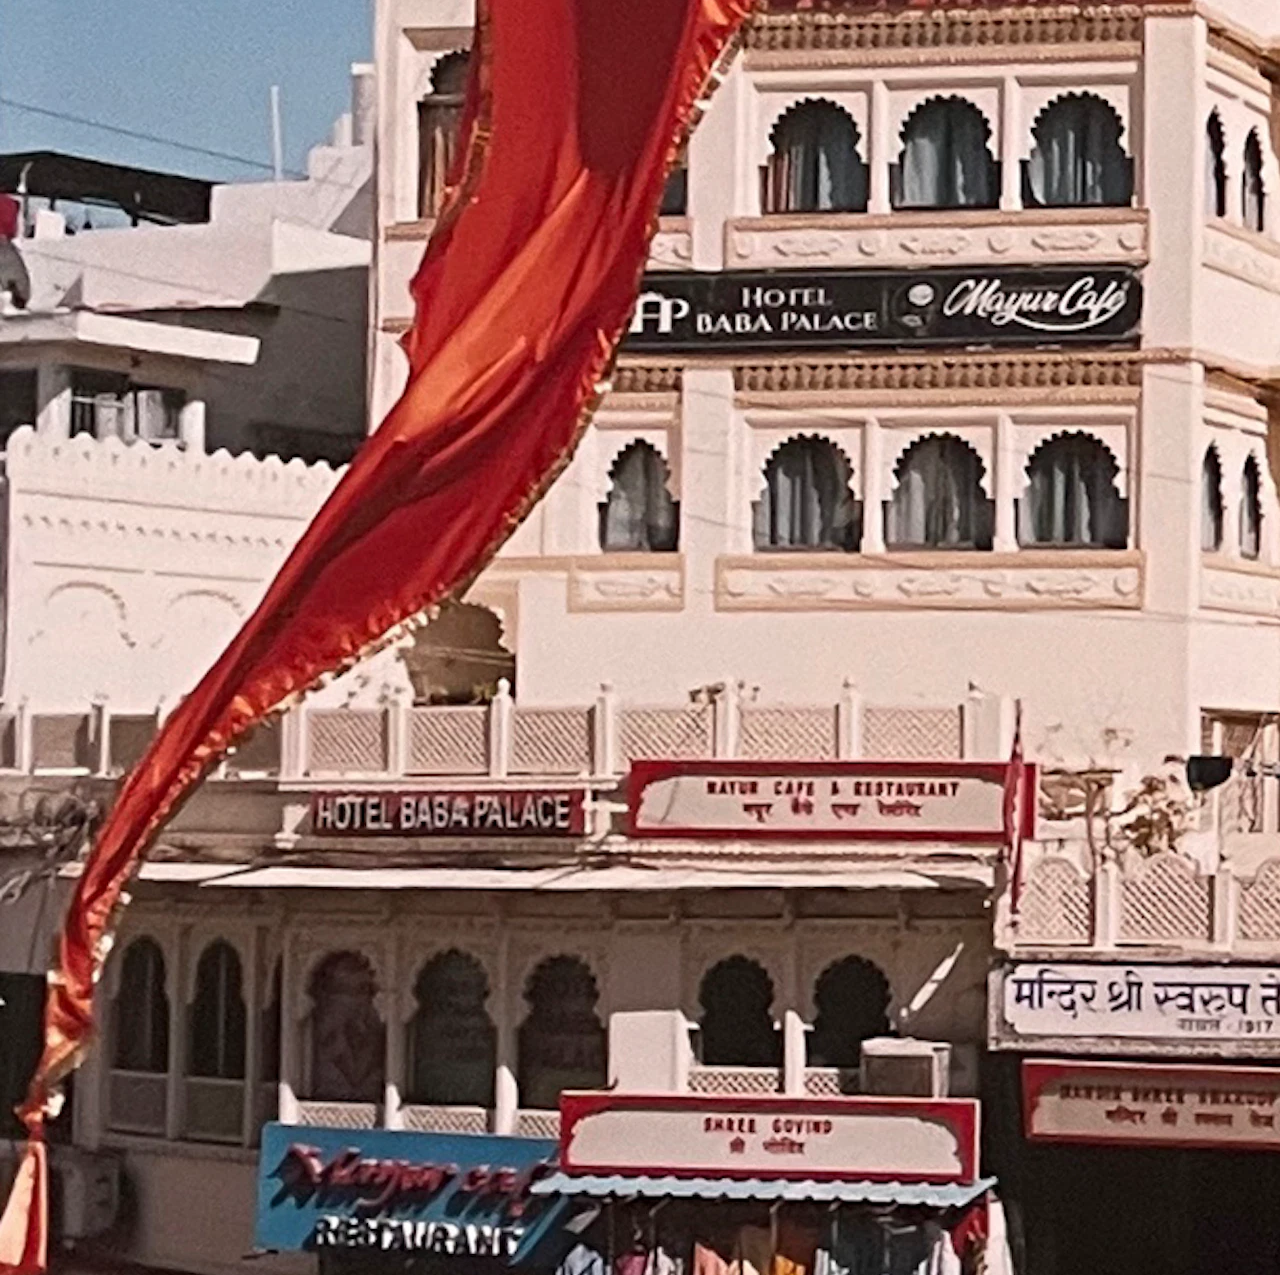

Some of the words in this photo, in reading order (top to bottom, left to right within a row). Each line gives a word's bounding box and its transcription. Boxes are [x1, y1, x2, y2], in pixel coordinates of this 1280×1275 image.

[628, 291, 690, 333] AP
[697, 313, 773, 333] BABA
[780, 312, 877, 332] PALACE
[742, 286, 832, 308] HOTEL
[943, 279, 1060, 326] Mayur
[854, 781, 959, 797] RESTAURANT
[317, 795, 393, 830] HOTEL
[400, 795, 469, 829] BABA
[472, 793, 570, 828] PALACE
[1012, 969, 1096, 1019] मन्दिर
[1107, 970, 1143, 1014] श्री
